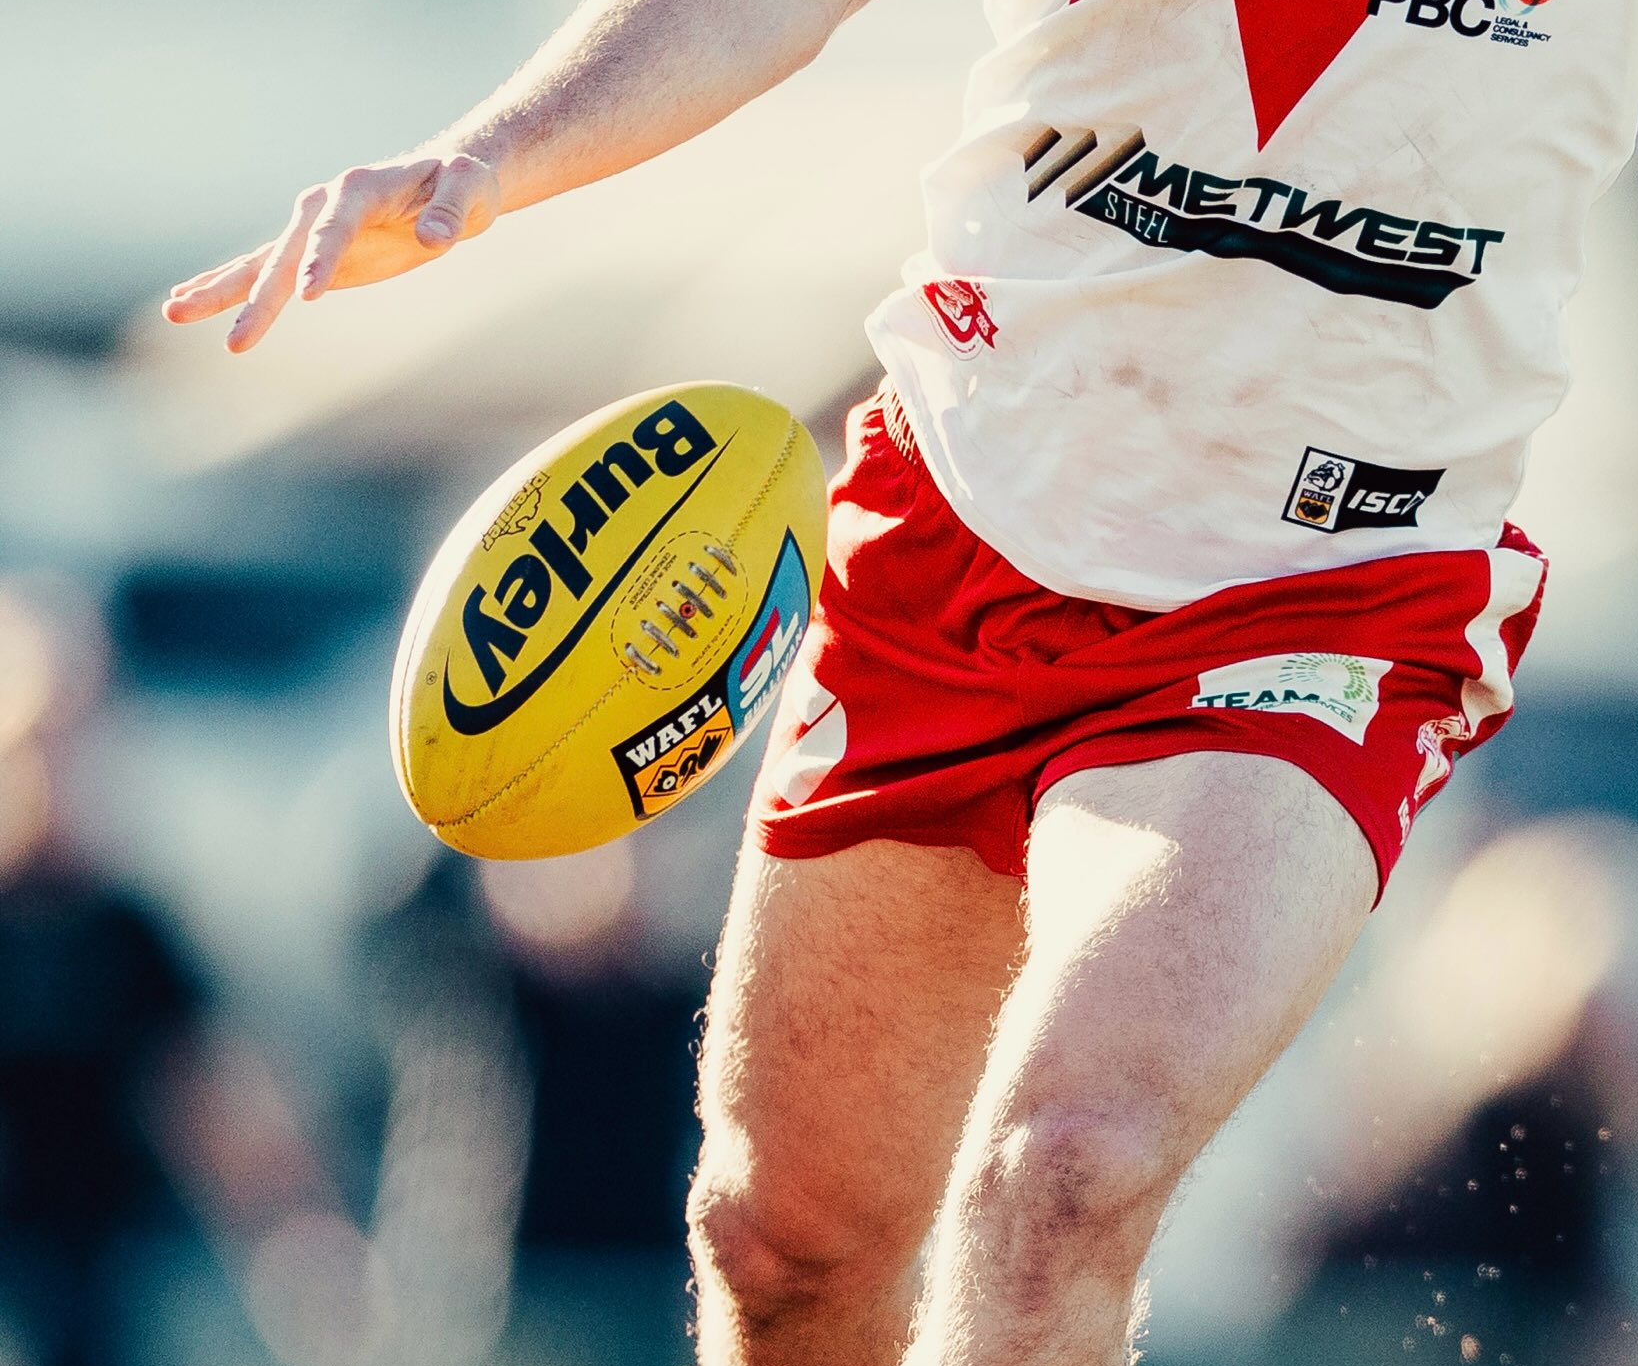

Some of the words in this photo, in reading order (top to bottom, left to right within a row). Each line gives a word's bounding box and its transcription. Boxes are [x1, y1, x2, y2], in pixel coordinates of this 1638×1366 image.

[1493, 24, 1552, 42] CONSULTANCY
[1495, 15, 1521, 28] LEGAL
[1490, 33, 1529, 47] SERVICES
[1104, 193, 1170, 244] STEEL
[1114, 150, 1506, 275] METWEST
[1302, 490, 1333, 504] WAFL
[1347, 489, 1412, 515] ISC
[482, 470, 551, 552] Premier
[463, 399, 718, 698] Burley
[1197, 689, 1321, 709] TEAM
[625, 693, 723, 769] WAFL
